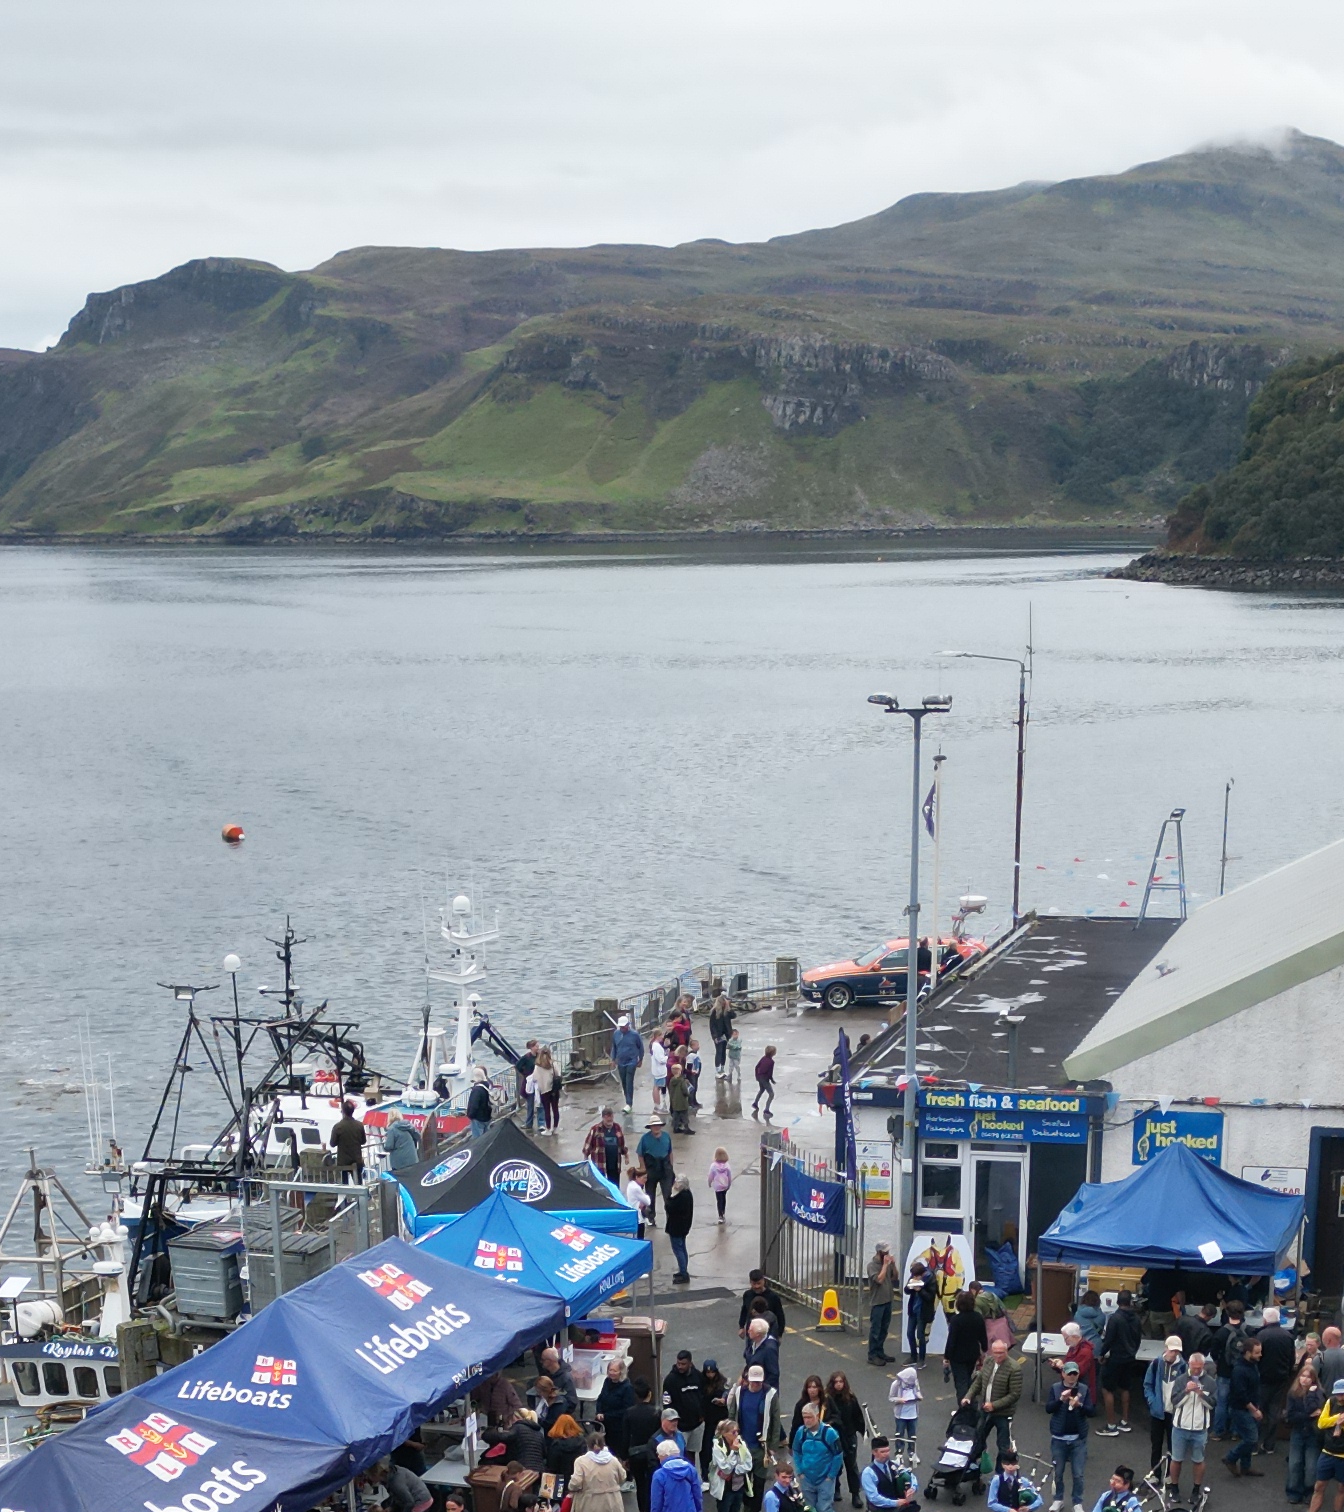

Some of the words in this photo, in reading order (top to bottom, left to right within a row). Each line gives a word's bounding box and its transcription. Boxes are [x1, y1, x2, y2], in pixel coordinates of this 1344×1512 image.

[925, 1094, 964, 1107] fresh
[969, 1094, 996, 1108] fish
[1001, 1096, 1013, 1109] &
[1018, 1097, 1080, 1112] seafood
[981, 1120, 1024, 1131] hooked
[1146, 1119, 1177, 1137] just
[555, 1244, 620, 1283] Lifeboats
[355, 1303, 471, 1375] Lifeboats
[178, 1380, 293, 1409] Lifeboats
